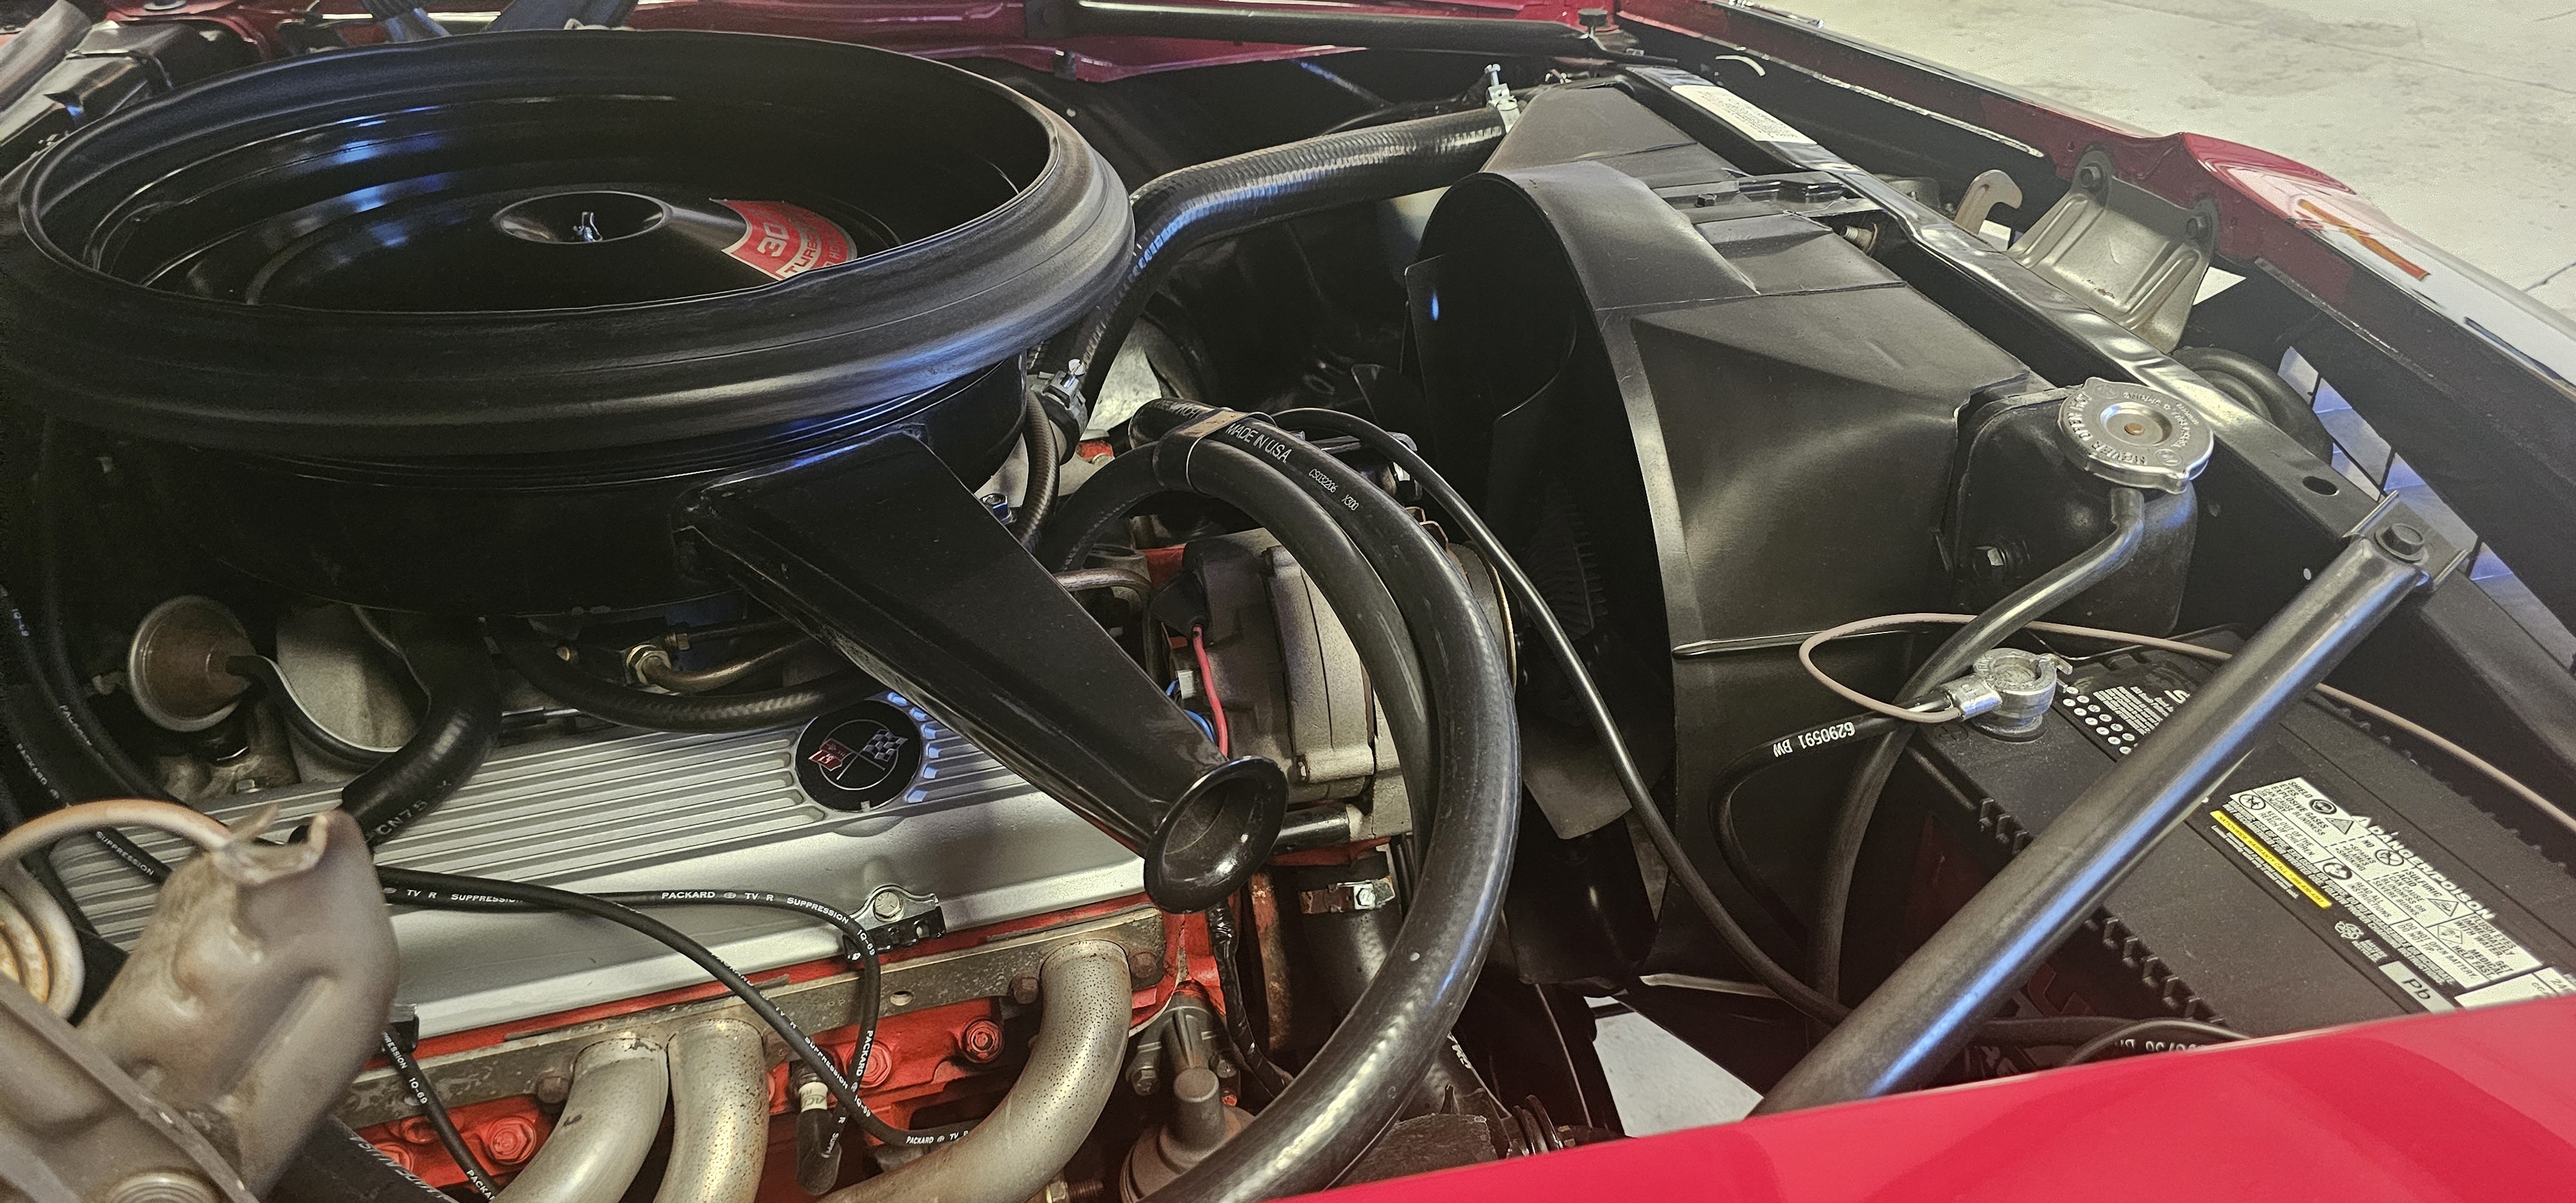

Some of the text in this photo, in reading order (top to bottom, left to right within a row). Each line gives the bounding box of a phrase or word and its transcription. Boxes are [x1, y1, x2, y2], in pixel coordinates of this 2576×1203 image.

[1225, 422, 1258, 443] MADE
[1254, 434, 1269, 449] IN
[2067, 412, 2093, 442] OPEN
[2091, 440, 2148, 465] NEVER
[1773, 721, 1855, 757] 6290591 BW
[2278, 783, 2302, 798] EYES.
[2287, 781, 2313, 799] SHIELD
[2262, 788, 2326, 836] CAN CAUSE BLINDNESS
[2269, 786, 2329, 829] EXPLOSIVE GASES
[2257, 812, 2280, 827] REACH
[2282, 833, 2318, 857] CHILDREN.
[2264, 810, 2283, 822] KEEP
[2280, 822, 2295, 831] OUT
[2298, 837, 2315, 847] THE
[96, 831, 155, 876] SUPPRESSION
[2216, 816, 2249, 839] NATIONWIDE
[2245, 840, 2277, 862] WARRANTY
[2272, 862, 2290, 873] CALL
[2360, 839, 2376, 848] NO
[2365, 824, 2497, 920] DANGER/POISON
[2396, 873, 2418, 887] ACID
[2404, 870, 2443, 897] SULFURIC
[2345, 883, 2394, 919] INSTRUCTIONS.
[2353, 881, 2384, 904] READ ALL
[2371, 880, 2398, 898] SEVERE
[2380, 878, 2417, 904] BLINDNESS
[2388, 876, 2425, 902] CAN CAUSE
[661, 891, 716, 900] PACKARD
[744, 892, 759, 900] TV
[766, 893, 774, 902] R
[786, 896, 851, 925] SUPPRESSION
[2396, 924, 2436, 953] DO NOT TIP.
[2452, 920, 2506, 958] WITH WATER.
[2461, 918, 2515, 956] IMMEDIATELY
[2468, 915, 2517, 949] FLUSH EYES
[2414, 930, 2431, 941] NOT
[2427, 941, 2448, 955] OPEN
[2444, 954, 2478, 979] BATTERY.
[2450, 945, 2497, 978] HELP FAST.
[2467, 949, 2506, 975] MEDICAL
[2494, 960, 2514, 972] GET
[2401, 977, 2431, 1000] Pb
[856, 1030, 874, 1077] PACKARD
[408, 1077, 428, 1104] 1Q-69
[905, 1136, 934, 1144] PACKARD
